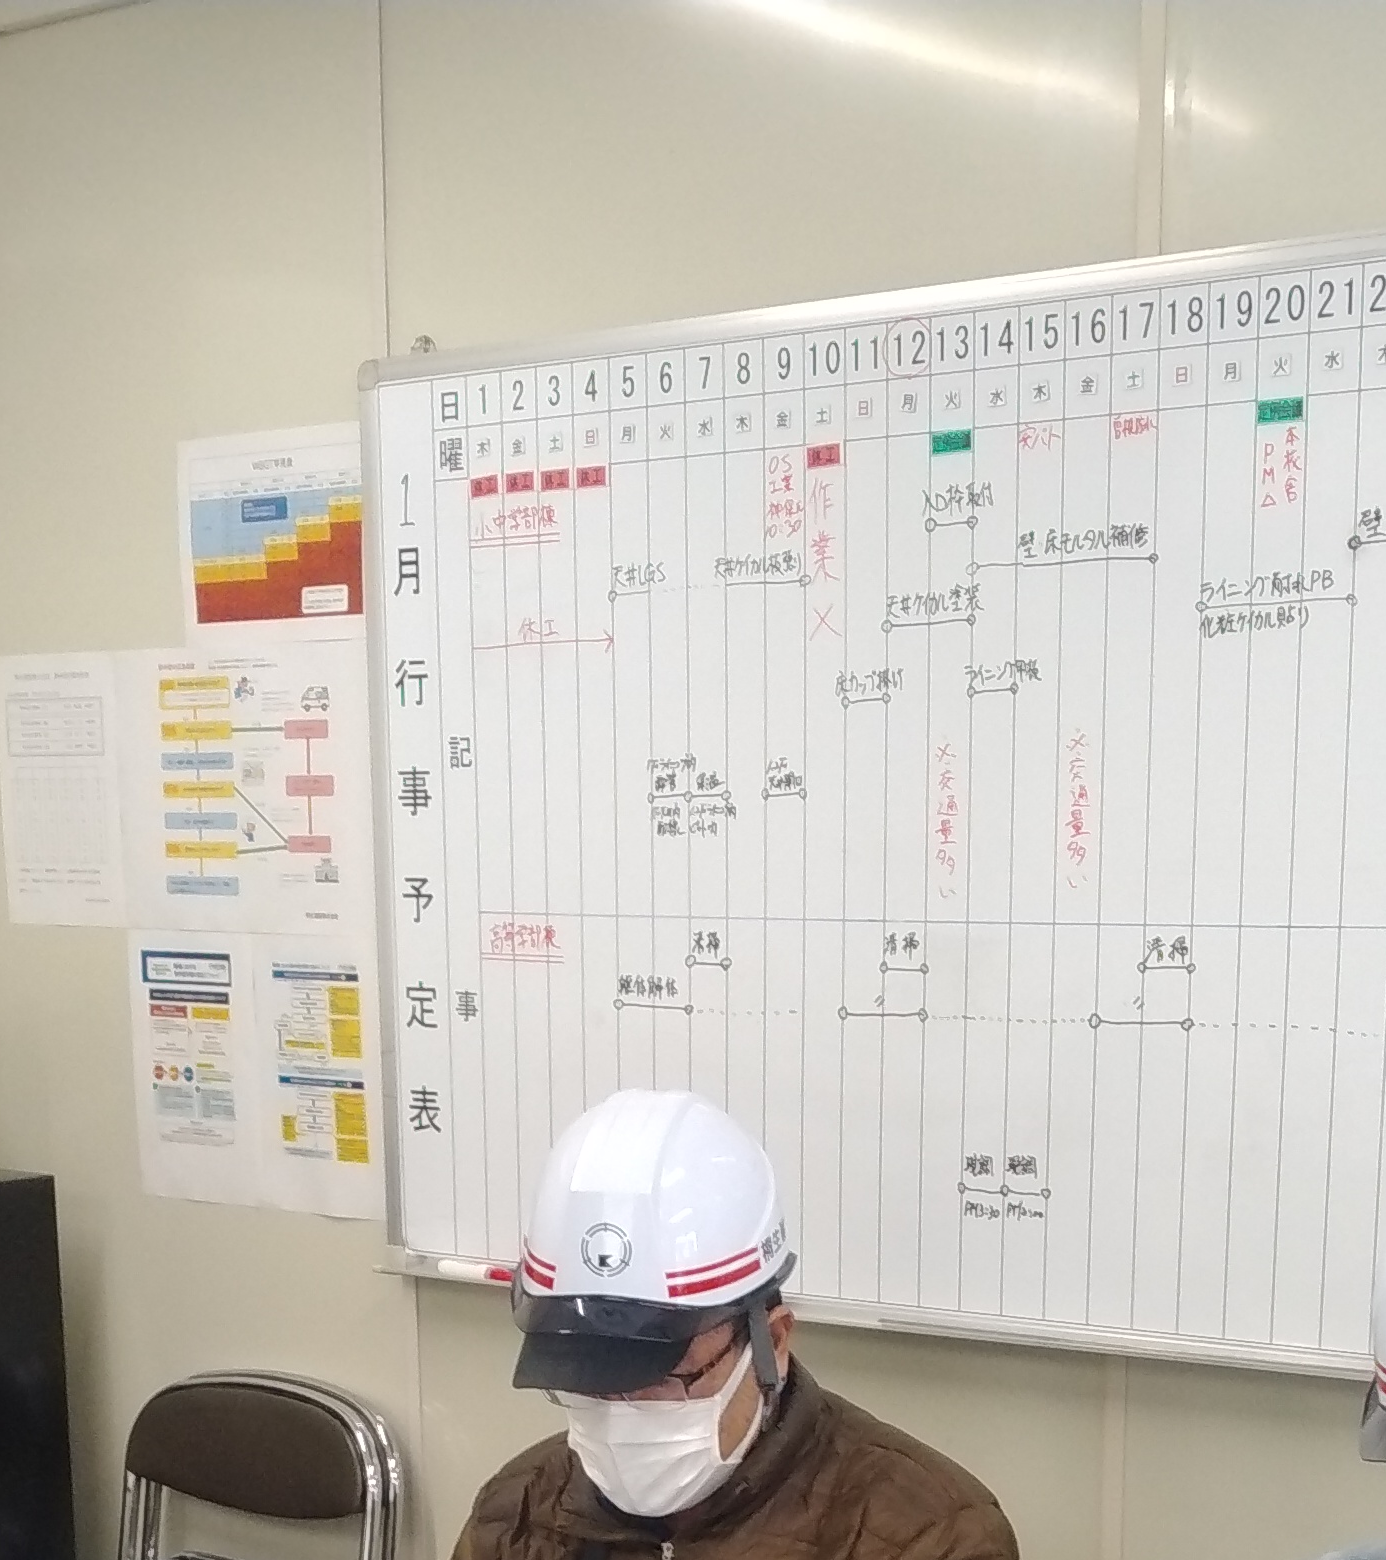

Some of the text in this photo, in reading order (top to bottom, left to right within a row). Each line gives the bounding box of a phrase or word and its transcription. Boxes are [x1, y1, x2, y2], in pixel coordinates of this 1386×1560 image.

[440, 392, 461, 420] 日
[479, 385, 486, 414] 1
[513, 380, 524, 411] 2
[548, 375, 560, 406] 3
[585, 370, 597, 402] 4
[622, 366, 634, 397] 5
[660, 362, 672, 393] 6
[699, 356, 710, 389] 7
[737, 353, 750, 384] 8
[778, 347, 790, 380] 9
[809, 341, 840, 376] 10
[851, 337, 878, 371] 11
[894, 333, 925, 367] 12
[937, 326, 968, 361] 13
[981, 320, 1013, 356] 14
[1025, 314, 1058, 351] 15
[1072, 309, 1105, 346] 16
[1119, 302, 1154, 340] 17
[1168, 297, 1203, 335] 18
[1217, 291, 1252, 329] 19
[1264, 285, 1305, 324] 20
[1318, 279, 1353, 318] 21
[440, 439, 464, 471] 曜
[477, 439, 490, 458] 木
[512, 438, 525, 457] 金
[549, 436, 563, 453] 土
[584, 428, 599, 448] 日
[620, 425, 636, 443] 月
[660, 425, 673, 440] 火
[698, 417, 712, 437] 水
[736, 415, 750, 431] 木
[777, 412, 791, 428] 金
[816, 406, 831, 424] 土
[859, 398, 871, 418] 日
[901, 393, 917, 413] 月
[945, 391, 961, 409] 火
[990, 388, 1006, 407] 水
[1033, 382, 1050, 401] 木
[1080, 376, 1097, 395] 金
[1127, 370, 1144, 390] 土
[1176, 367, 1188, 386] 日
[1224, 363, 1241, 382] 月
[1272, 357, 1288, 377] 火
[1325, 351, 1339, 370] 水
